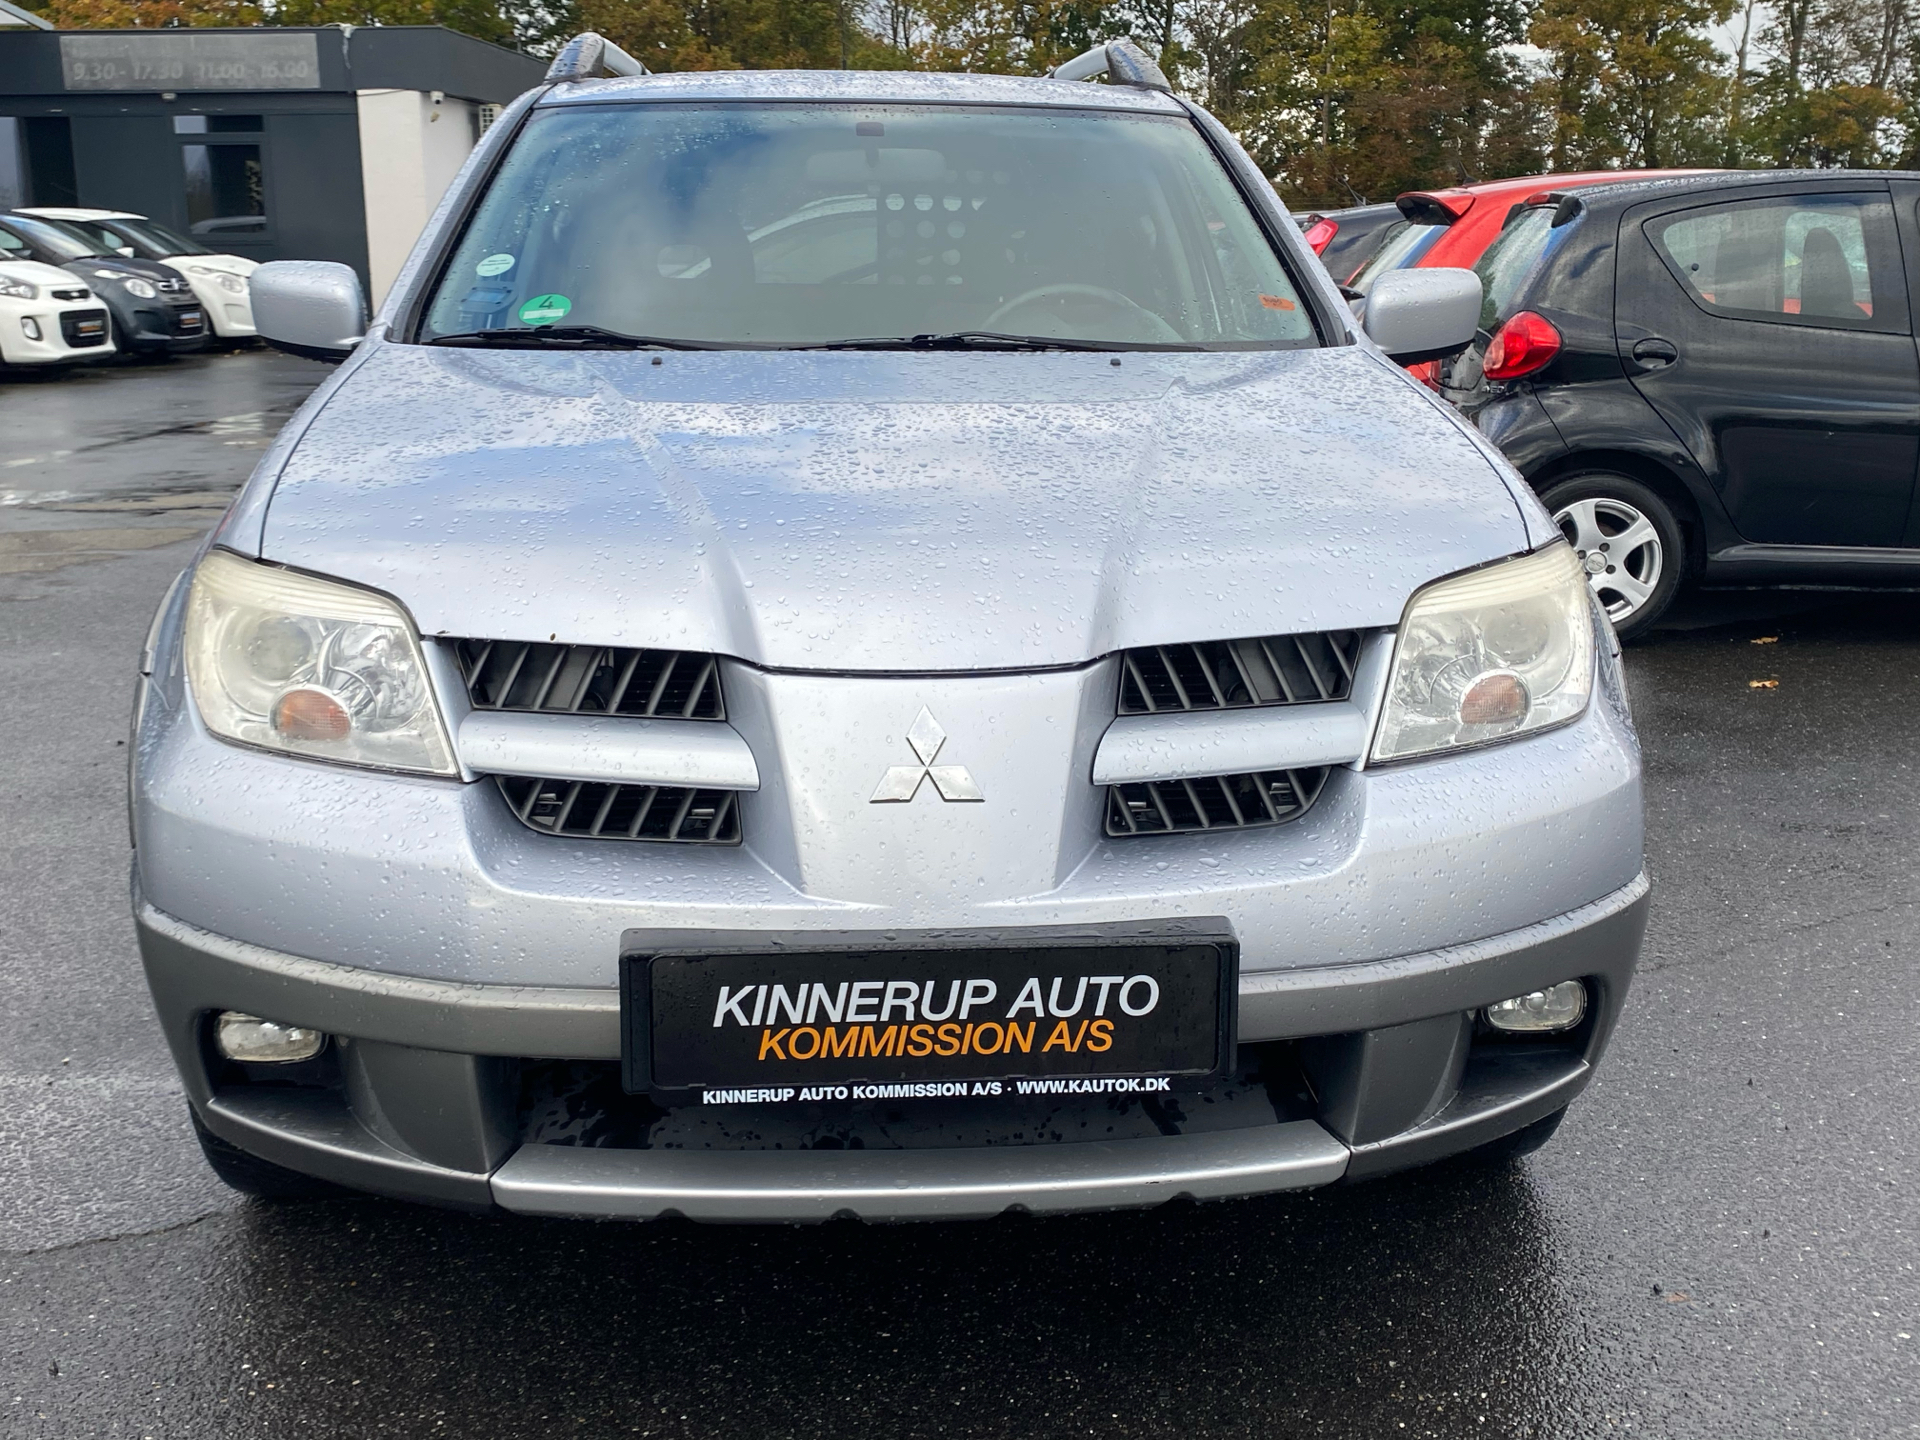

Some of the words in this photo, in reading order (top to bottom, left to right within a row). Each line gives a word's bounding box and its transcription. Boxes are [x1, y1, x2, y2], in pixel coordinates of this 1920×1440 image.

[73, 61, 116, 81] 9.30
[538, 295, 554, 309] 4
[712, 979, 998, 1028] KINNERUP
[1005, 975, 1160, 1019] AUTO
[758, 1021, 1037, 1061] KOMMISSION
[1041, 1019, 1115, 1053] A/S
[702, 1088, 795, 1105] KINNERUP
[798, 1086, 849, 1102] AUTO
[852, 1082, 968, 1099] KOMMISSION
[970, 1081, 1003, 1096] A/S
[1015, 1077, 1171, 1095] WWW.KAUTOK.DK
